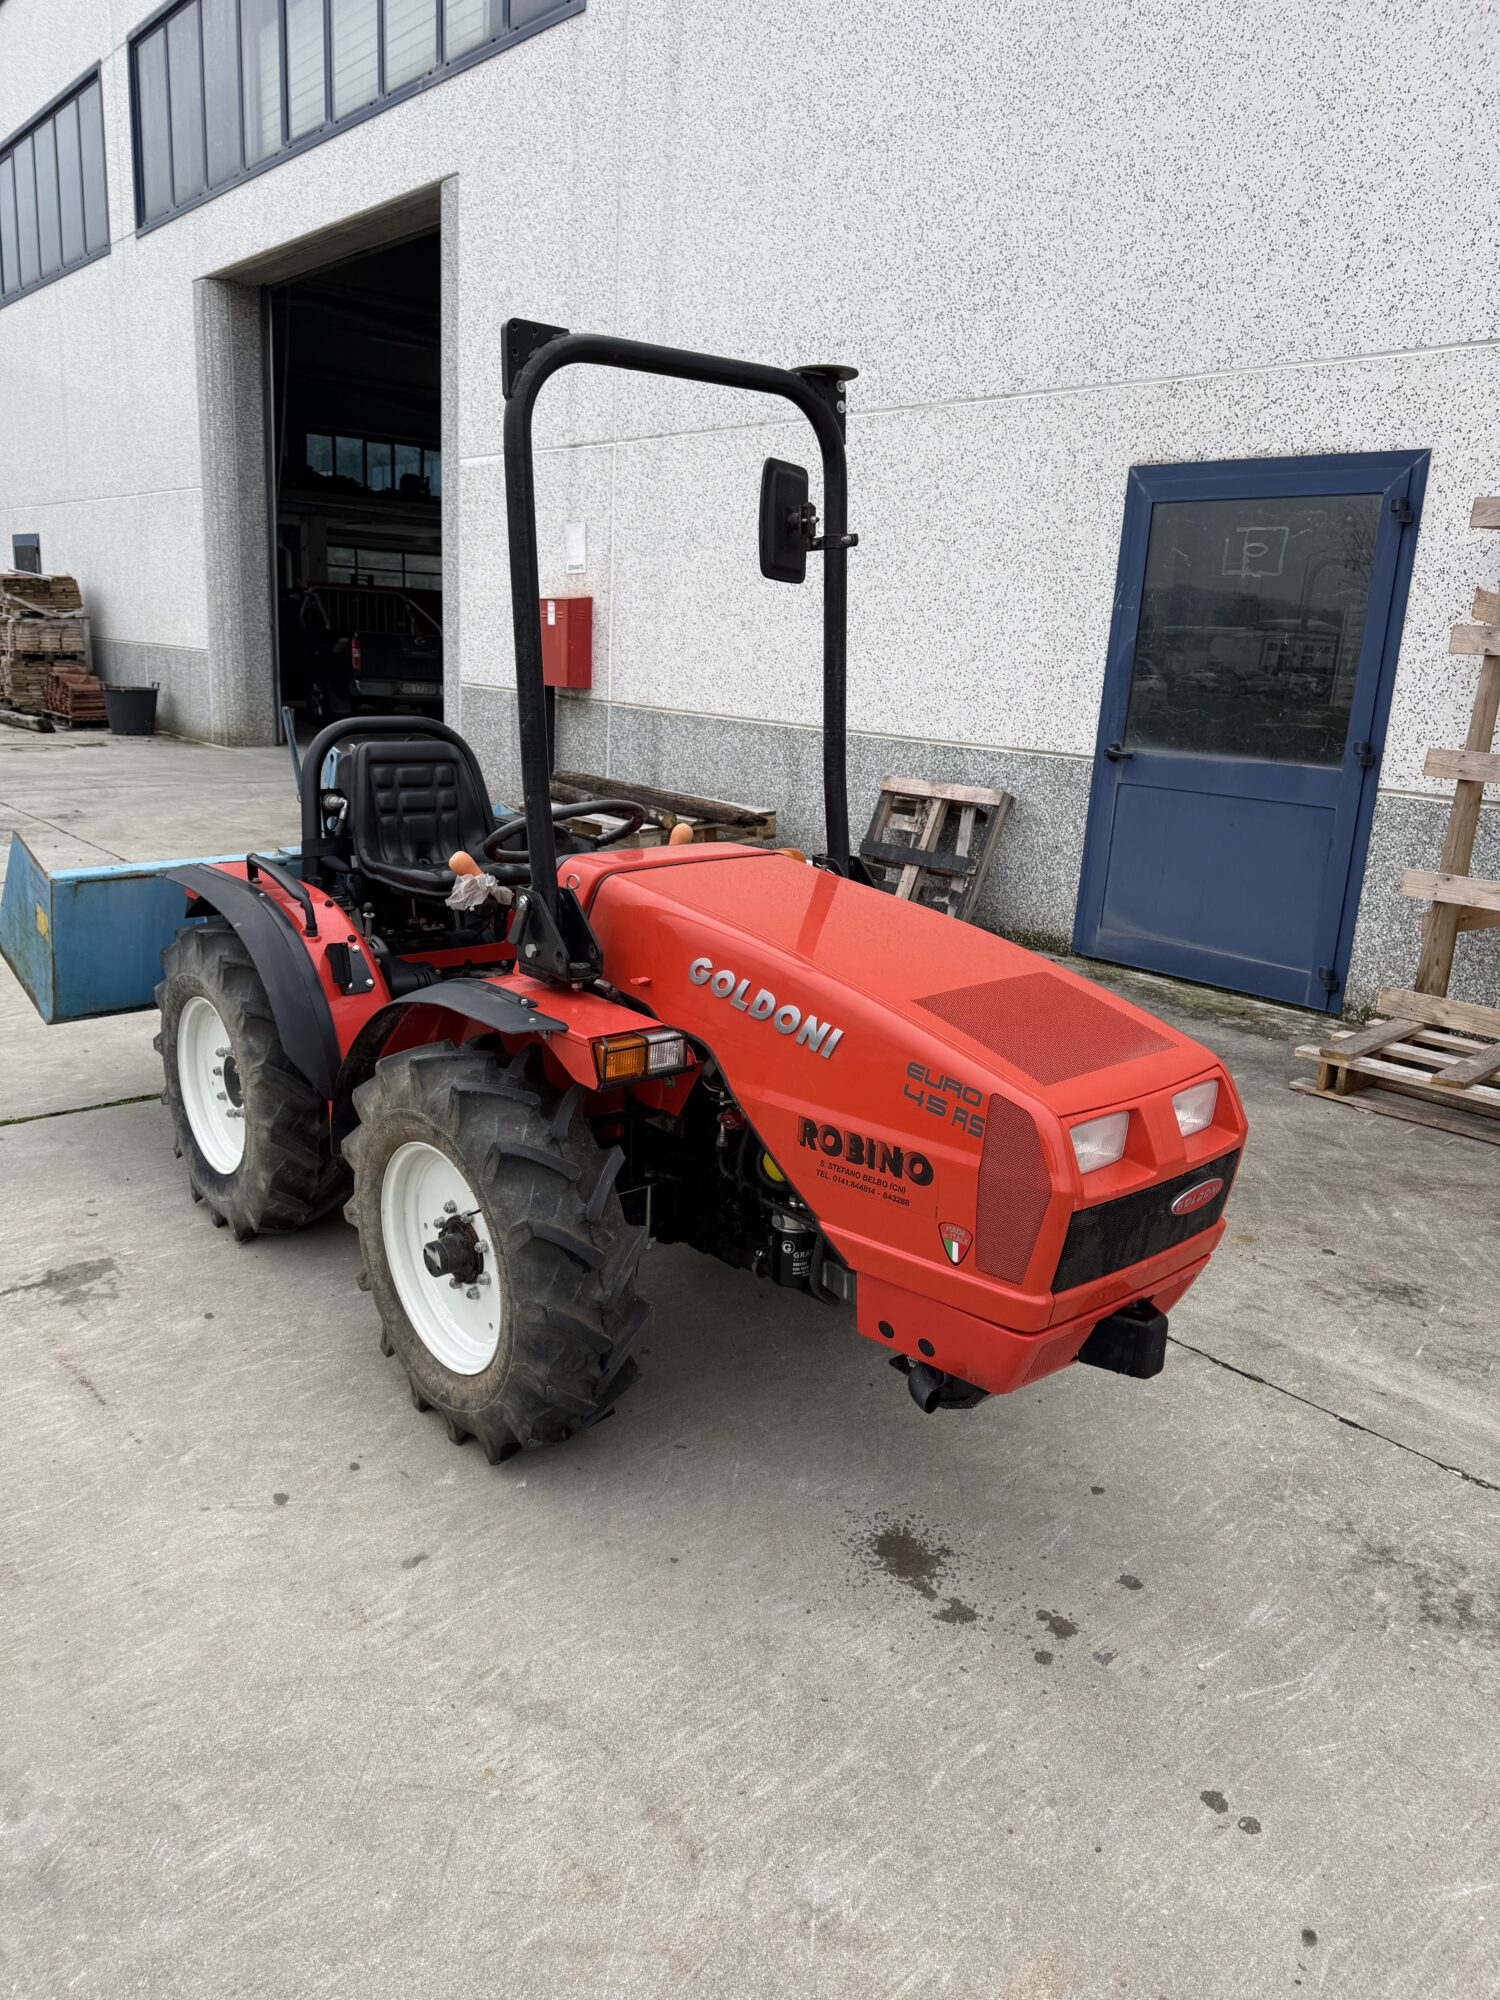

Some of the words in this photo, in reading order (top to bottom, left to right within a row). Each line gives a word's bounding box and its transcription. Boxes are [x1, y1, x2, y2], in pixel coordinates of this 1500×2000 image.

[689, 957, 845, 1060] GOLDONI
[906, 1061, 982, 1107] EURO
[903, 1084, 947, 1117] 45
[951, 1106, 985, 1138] RS
[797, 1115, 934, 1187] ROBINO
[816, 1169, 831, 1180] TEL.
[832, 1174, 875, 1195] 0141.844814
[819, 1160, 827, 1168] S.
[828, 1161, 861, 1179] STEFANO
[862, 1174, 888, 1188] BELBO
[889, 1183, 906, 1195] (CN)
